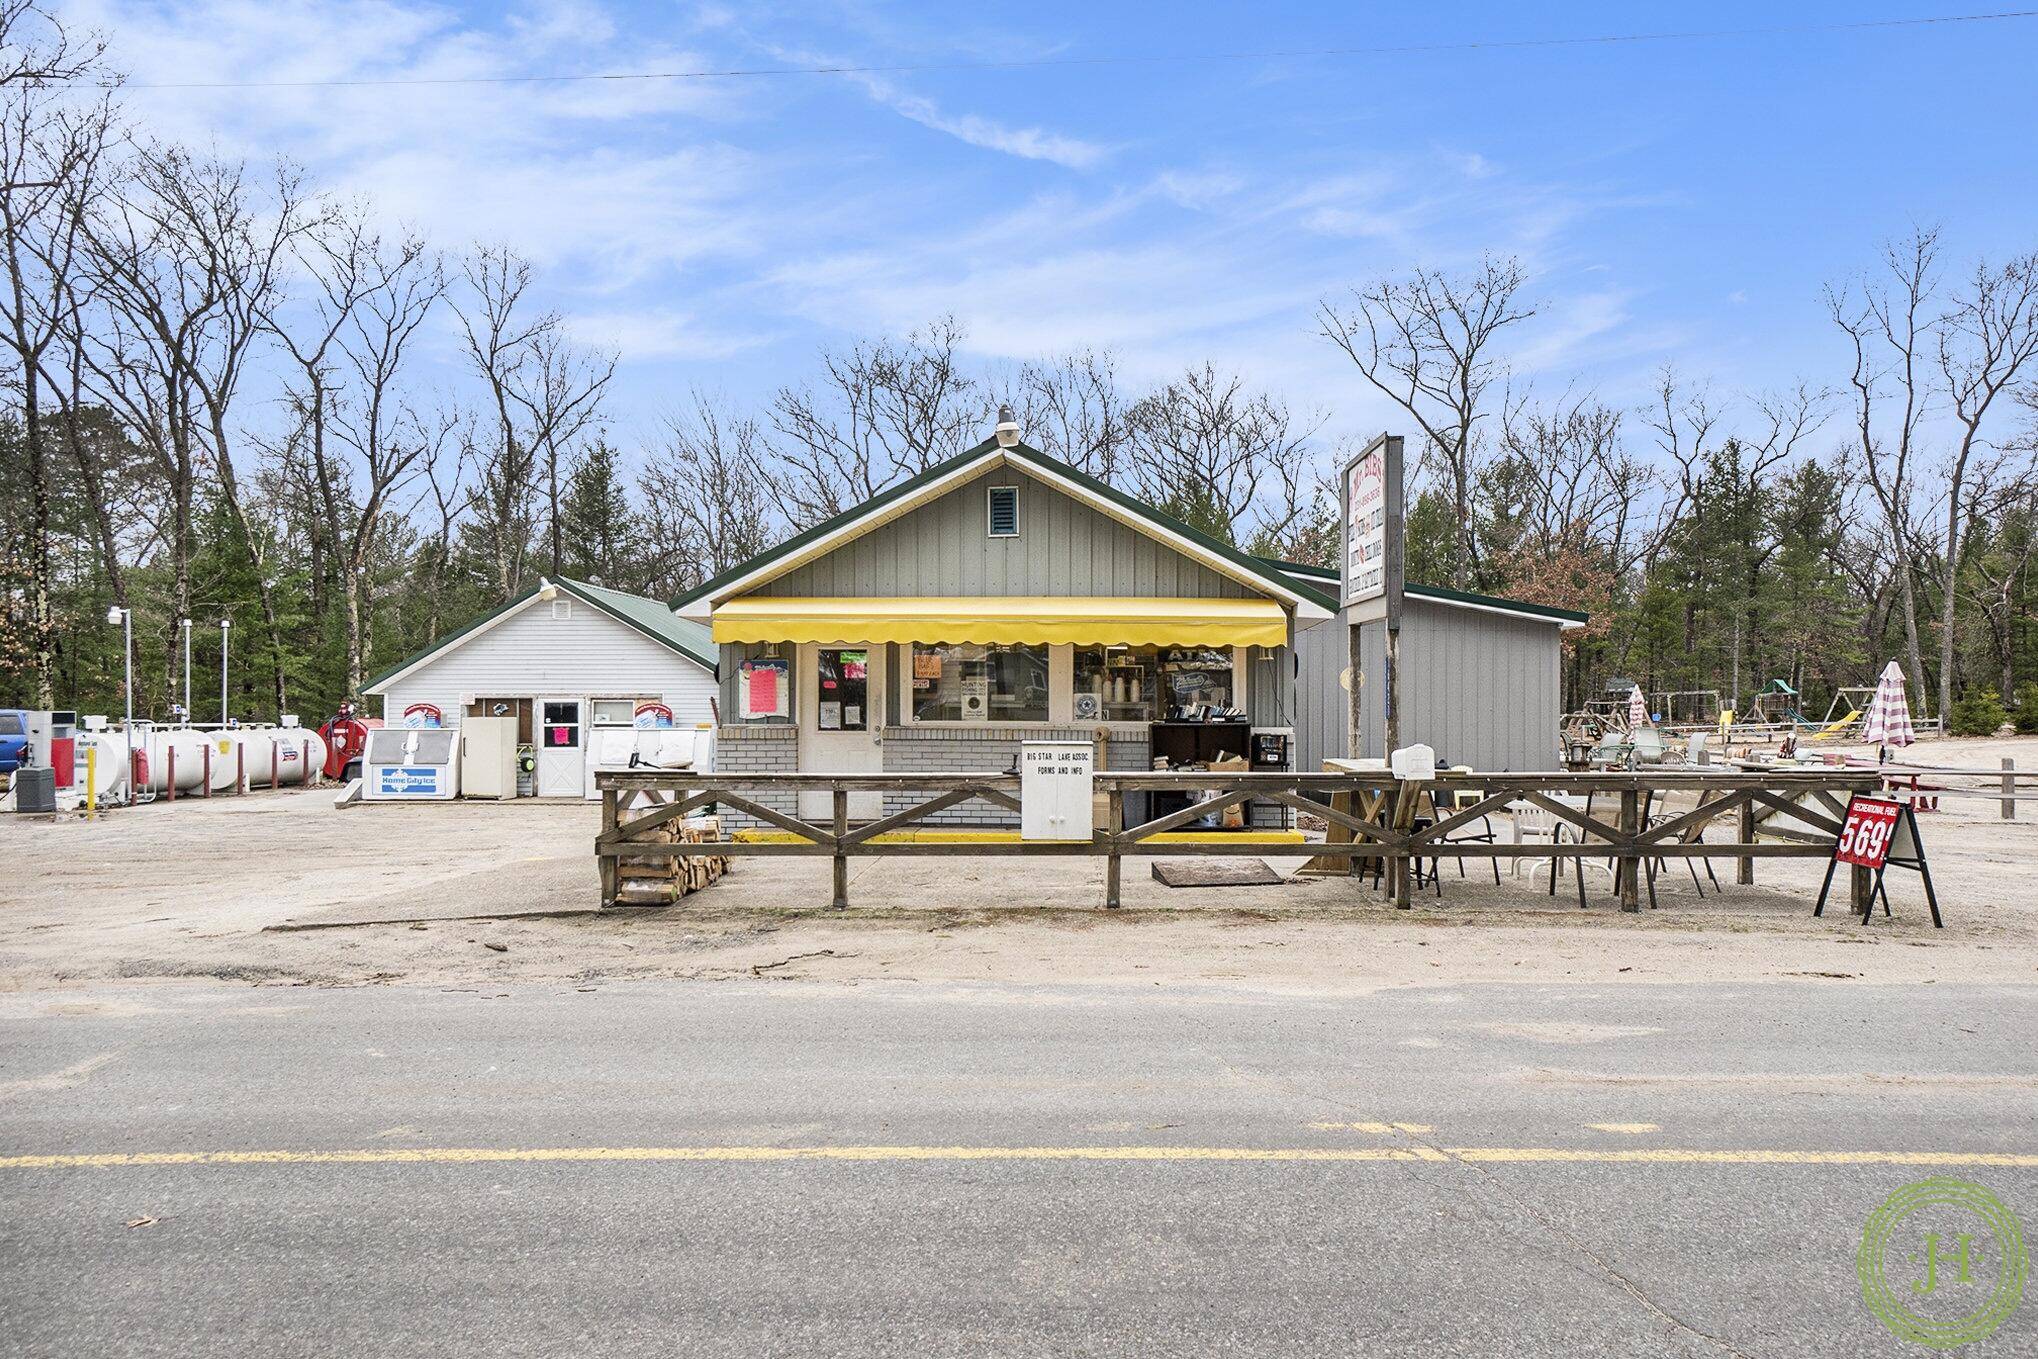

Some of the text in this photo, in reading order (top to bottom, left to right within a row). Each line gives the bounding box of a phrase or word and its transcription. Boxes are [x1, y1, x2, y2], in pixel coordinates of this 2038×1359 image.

[1027, 752, 1089, 761] BIG STAR LAKE ASSOC
[1037, 766, 1083, 775] FORMS AND INFO
[407, 777, 423, 785] City
[1853, 803, 1897, 816] RECREATIONAL FUEL
